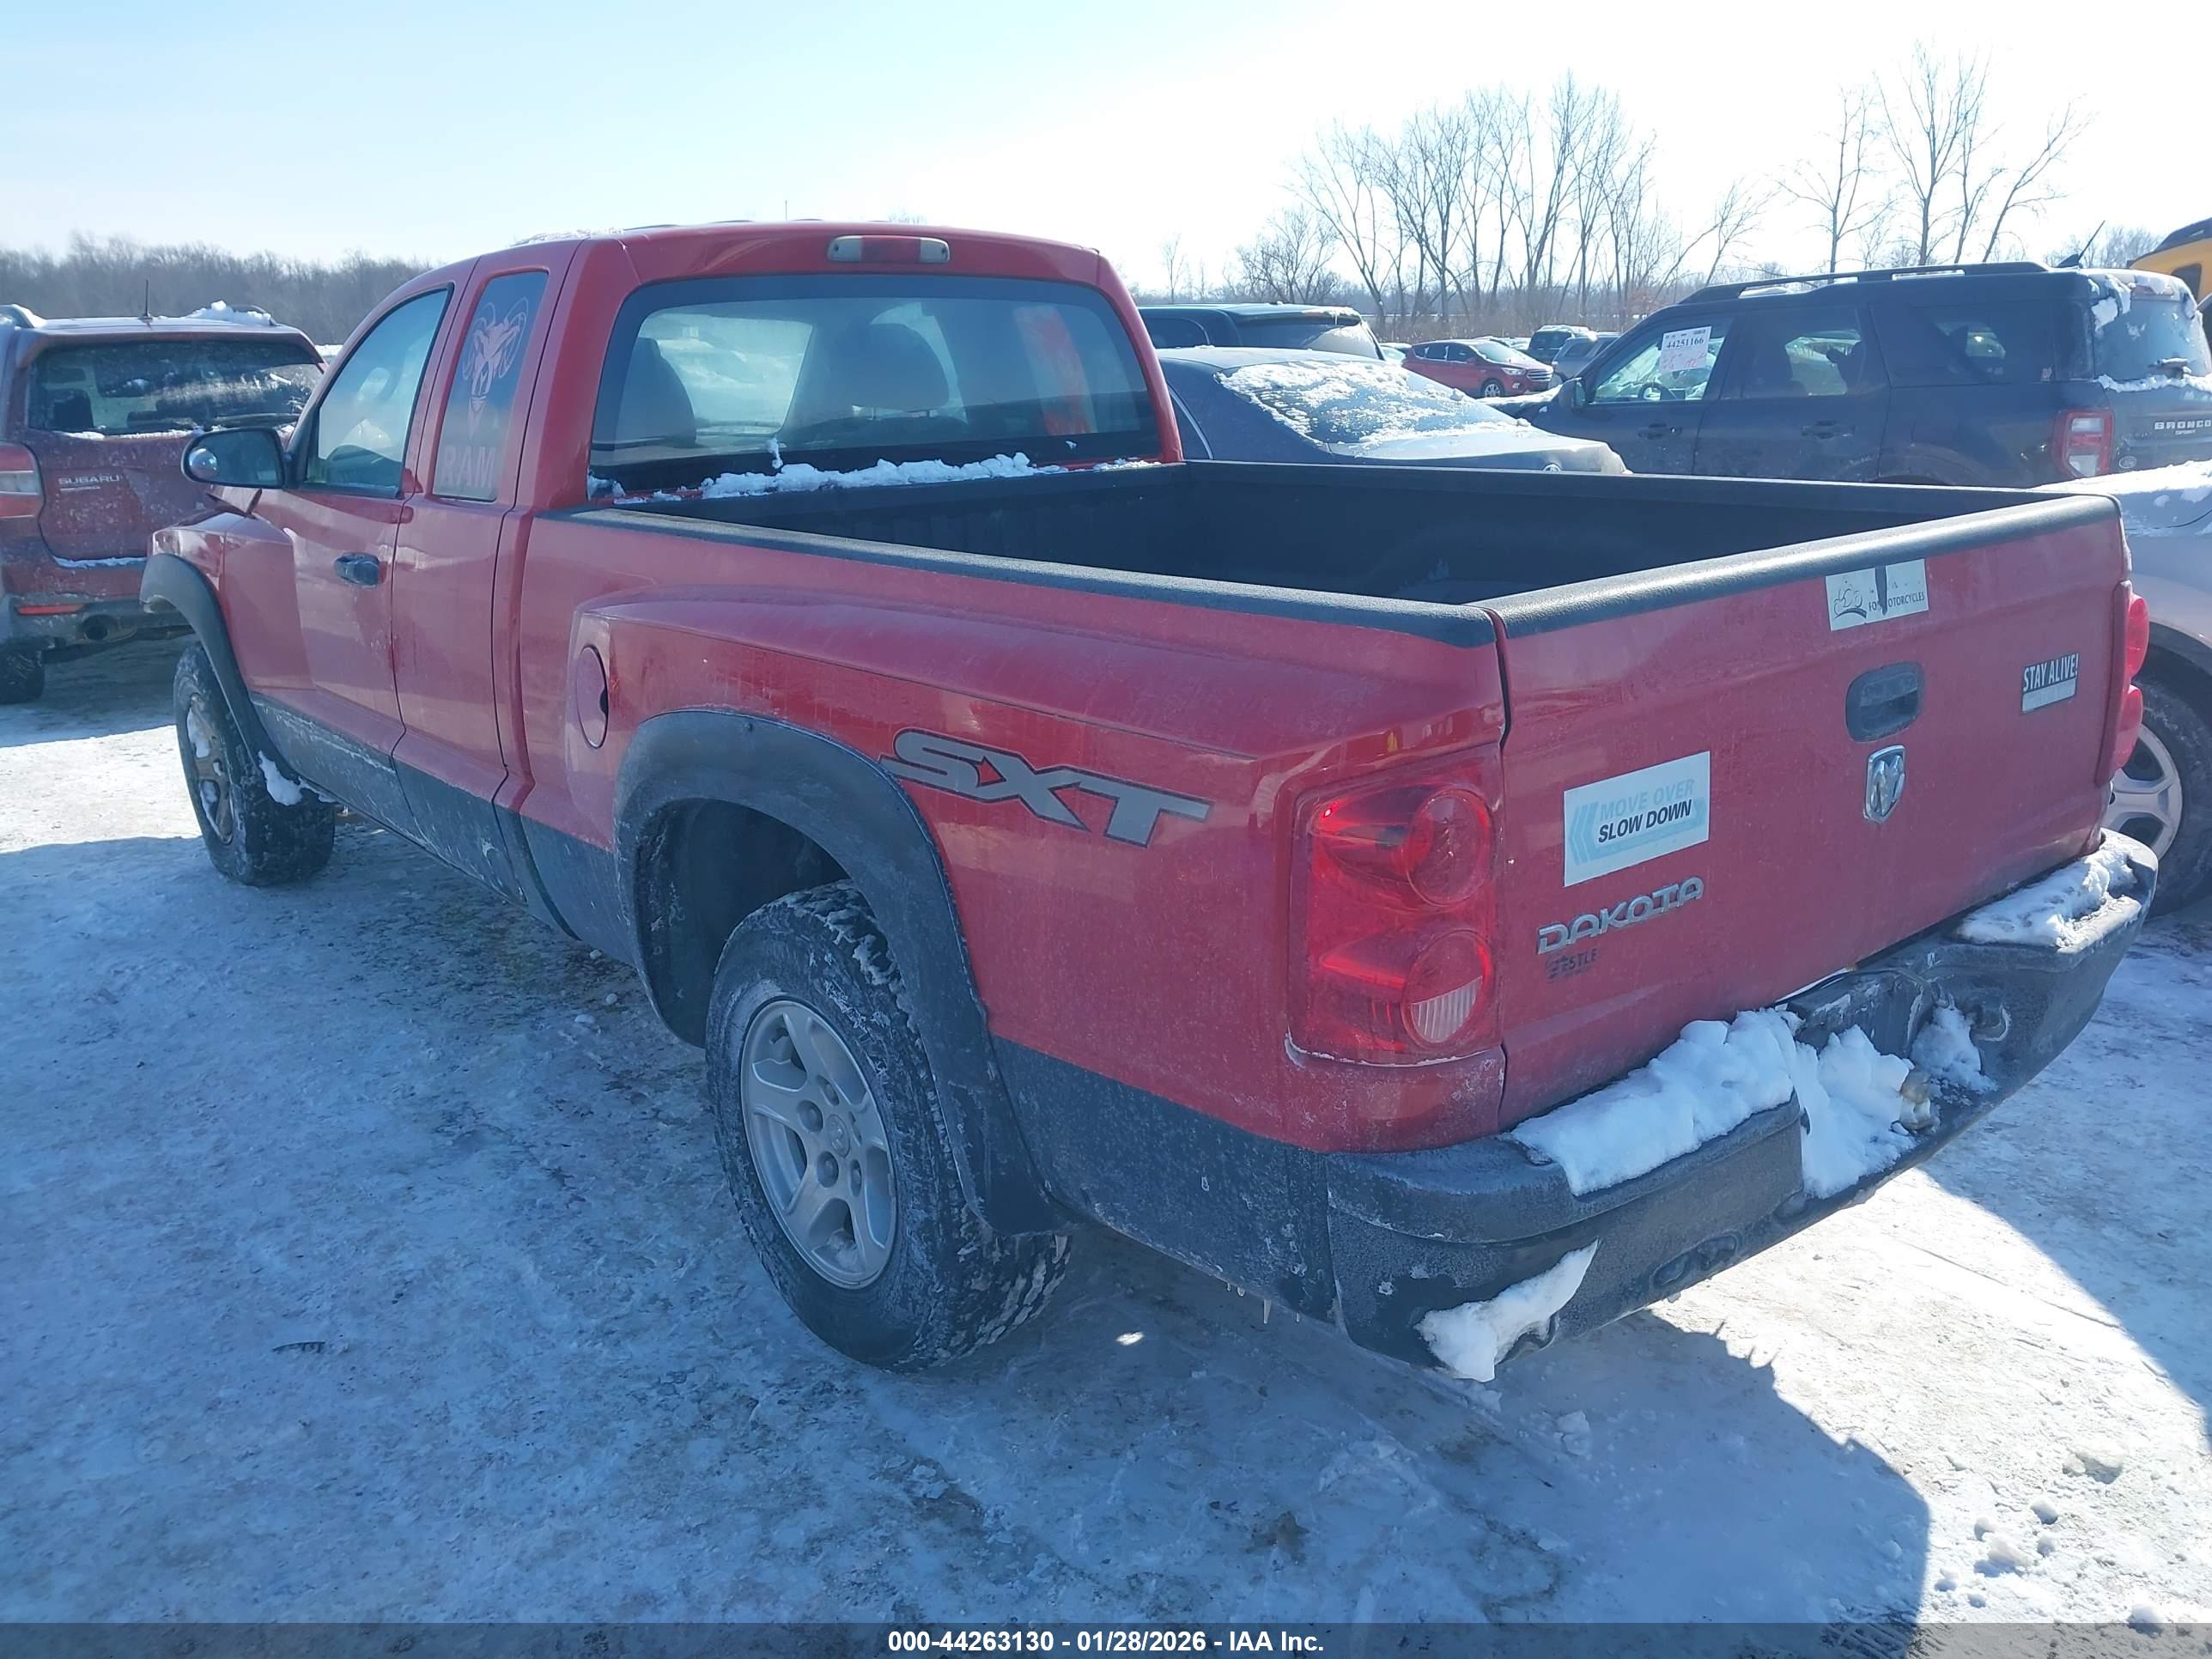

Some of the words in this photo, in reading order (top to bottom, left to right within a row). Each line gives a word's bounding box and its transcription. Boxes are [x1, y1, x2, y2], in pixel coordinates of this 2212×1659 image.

[1665, 336, 1705, 349] 44251166
[2154, 419, 2212, 430] BRONCO
[58, 474, 120, 485] SUBARU
[441, 445, 497, 489] RAM
[1887, 591, 1925, 608] OTORCYCLES
[2023, 662, 2048, 692] STAY
[2048, 652, 2079, 684] ALIVE!
[878, 726, 1216, 849] SXT
[1600, 791, 1649, 822] MOVE
[1653, 778, 1696, 805] OVER
[1598, 813, 1644, 843] SLOW
[1645, 799, 1692, 830] DOWN
[1537, 876, 1705, 955] DAKOTA
